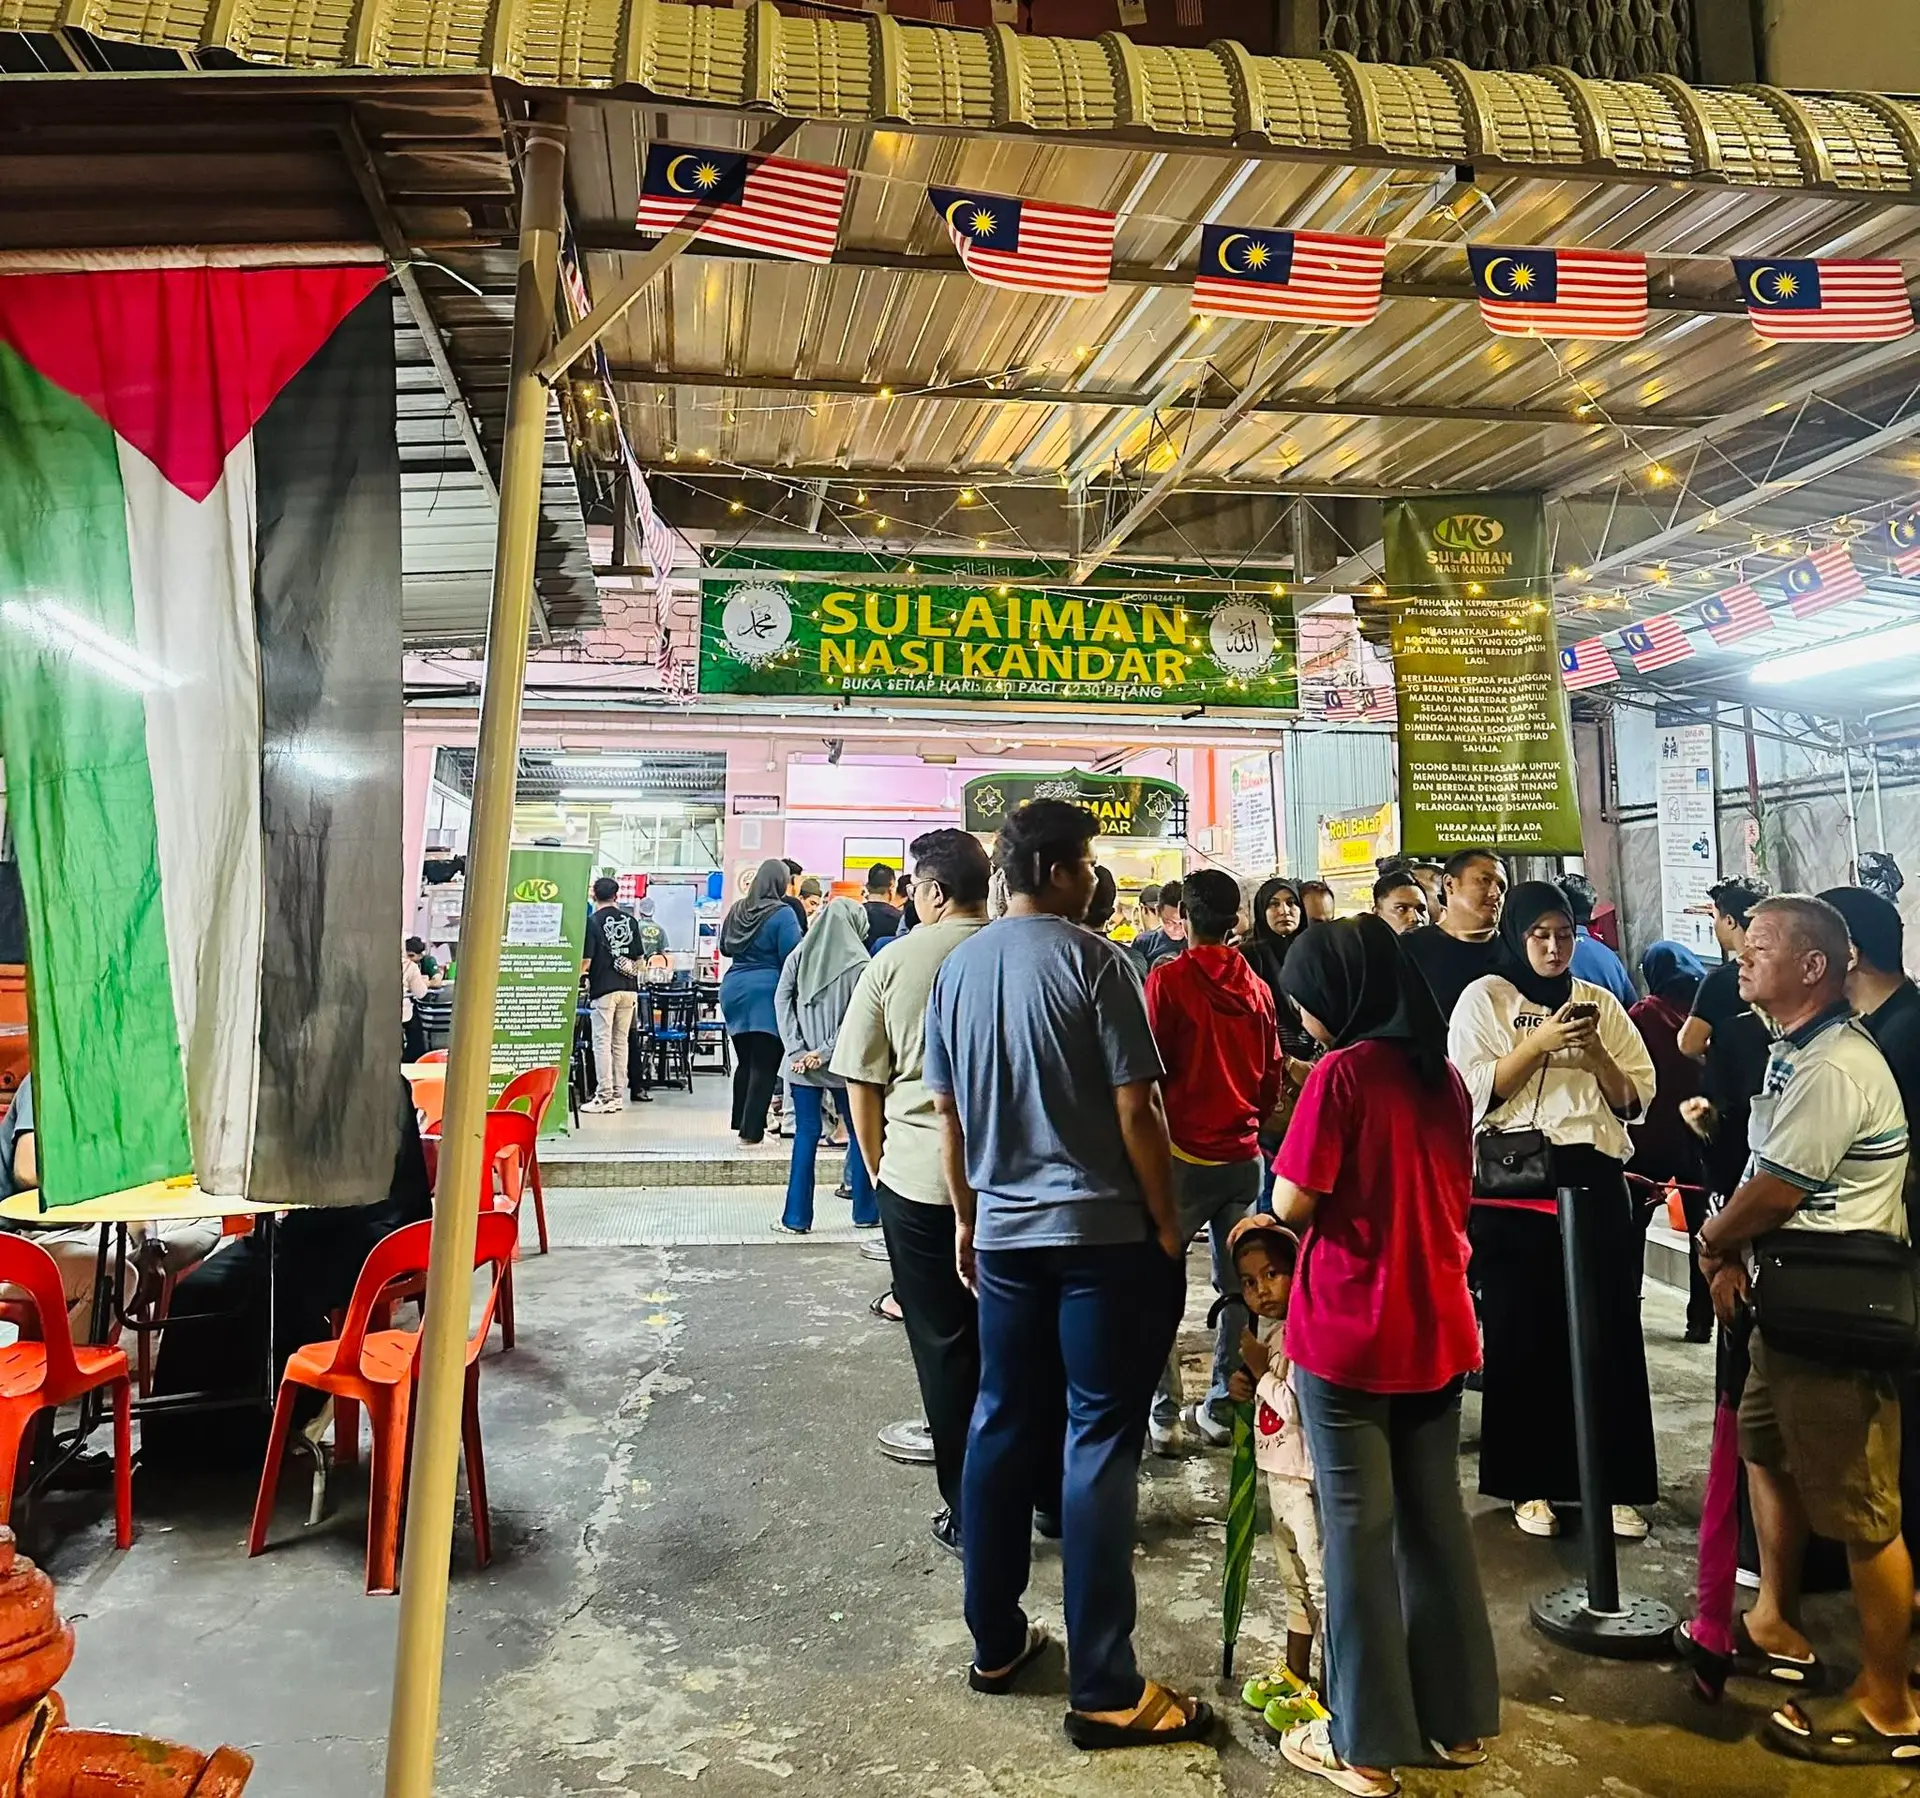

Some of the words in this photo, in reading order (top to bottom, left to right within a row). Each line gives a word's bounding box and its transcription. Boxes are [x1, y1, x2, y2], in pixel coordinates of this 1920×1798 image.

[1445, 518, 1495, 548] NKS
[1426, 551, 1513, 565] SULAIMAN
[1435, 565, 1460, 573] NASI
[1462, 565, 1505, 574] KANDAR
[1405, 608, 1460, 616] PELANGGAN
[1463, 609, 1489, 617] YANG
[820, 592, 1187, 645] SULAIMAN
[1421, 628, 1488, 636] DIASIHATKAN
[1405, 636, 1448, 645] BOOKING
[1478, 638, 1501, 646] YANG
[1505, 635, 1542, 646] KOSONG
[1403, 646, 1423, 654] JIKA
[1427, 647, 1450, 655] ANDA
[1486, 648, 1523, 656] BERATUR
[1524, 645, 1545, 653] JAUH
[820, 638, 945, 677] NASI
[962, 639, 1187, 684] KANDAR
[1465, 657, 1489, 665] LAGI.
[1460, 676, 1495, 684] KEPADA
[1498, 674, 1551, 685] PELANGGAN
[842, 677, 882, 690] BUKA
[888, 678, 935, 691] SETIAP
[1019, 682, 1056, 693] PAGI
[1105, 685, 1162, 698] PETANG
[1423, 685, 1459, 693] BERATUR
[1463, 686, 1516, 694] DIHADAPAN
[1519, 684, 1548, 692] UNTUK
[1409, 694, 1444, 702] MAKAN
[1447, 695, 1466, 703] DAN
[1469, 696, 1507, 704] BEREDAR
[1421, 704, 1450, 712] SELAGI
[1511, 703, 1538, 712] DAPAT
[1414, 714, 1456, 722] PINGGAN
[1459, 715, 1481, 723] NASI
[1506, 714, 1525, 723] KAD
[1446, 725, 1484, 733] JANGAN
[1487, 723, 1531, 733] BOOKING
[1415, 733, 1452, 741] KERANA
[1480, 735, 1513, 743] HANYA
[1515, 733, 1548, 741] TERHAD
[1463, 745, 1502, 753] SAHAJA.
[1410, 763, 1449, 771] TOLONG
[1452, 764, 1469, 772] BERI
[1472, 763, 1527, 772] KERJASAMA
[1530, 762, 1561, 770] UNTUK
[1414, 773, 1481, 782] MEMUDAHKAN
[1484, 774, 1519, 782] PROSES
[1436, 783, 1475, 792] BEREDAR
[1478, 783, 1518, 792] DENGAN
[1521, 782, 1558, 791] TENANG
[1431, 793, 1451, 801] DAN
[1455, 794, 1483, 802] AMAN
[1486, 794, 1508, 802] BAGI
[1511, 793, 1542, 801] SEMUA
[1416, 803, 1473, 812] PELANGGAN
[1476, 803, 1503, 812] YANG
[1506, 802, 1559, 811] DISAYANGI.
[1329, 820, 1349, 840] Roti
[1351, 815, 1380, 836] Bakar
[1435, 823, 1468, 831] HARAP
[1470, 823, 1497, 831] MAAF
[1499, 823, 1520, 831] JIKA
[1522, 823, 1542, 831] ADA
[1439, 833, 1495, 842] KESALAHAN
[1497, 833, 1542, 842] BERLAKU.
[521, 881, 554, 900] NKS
